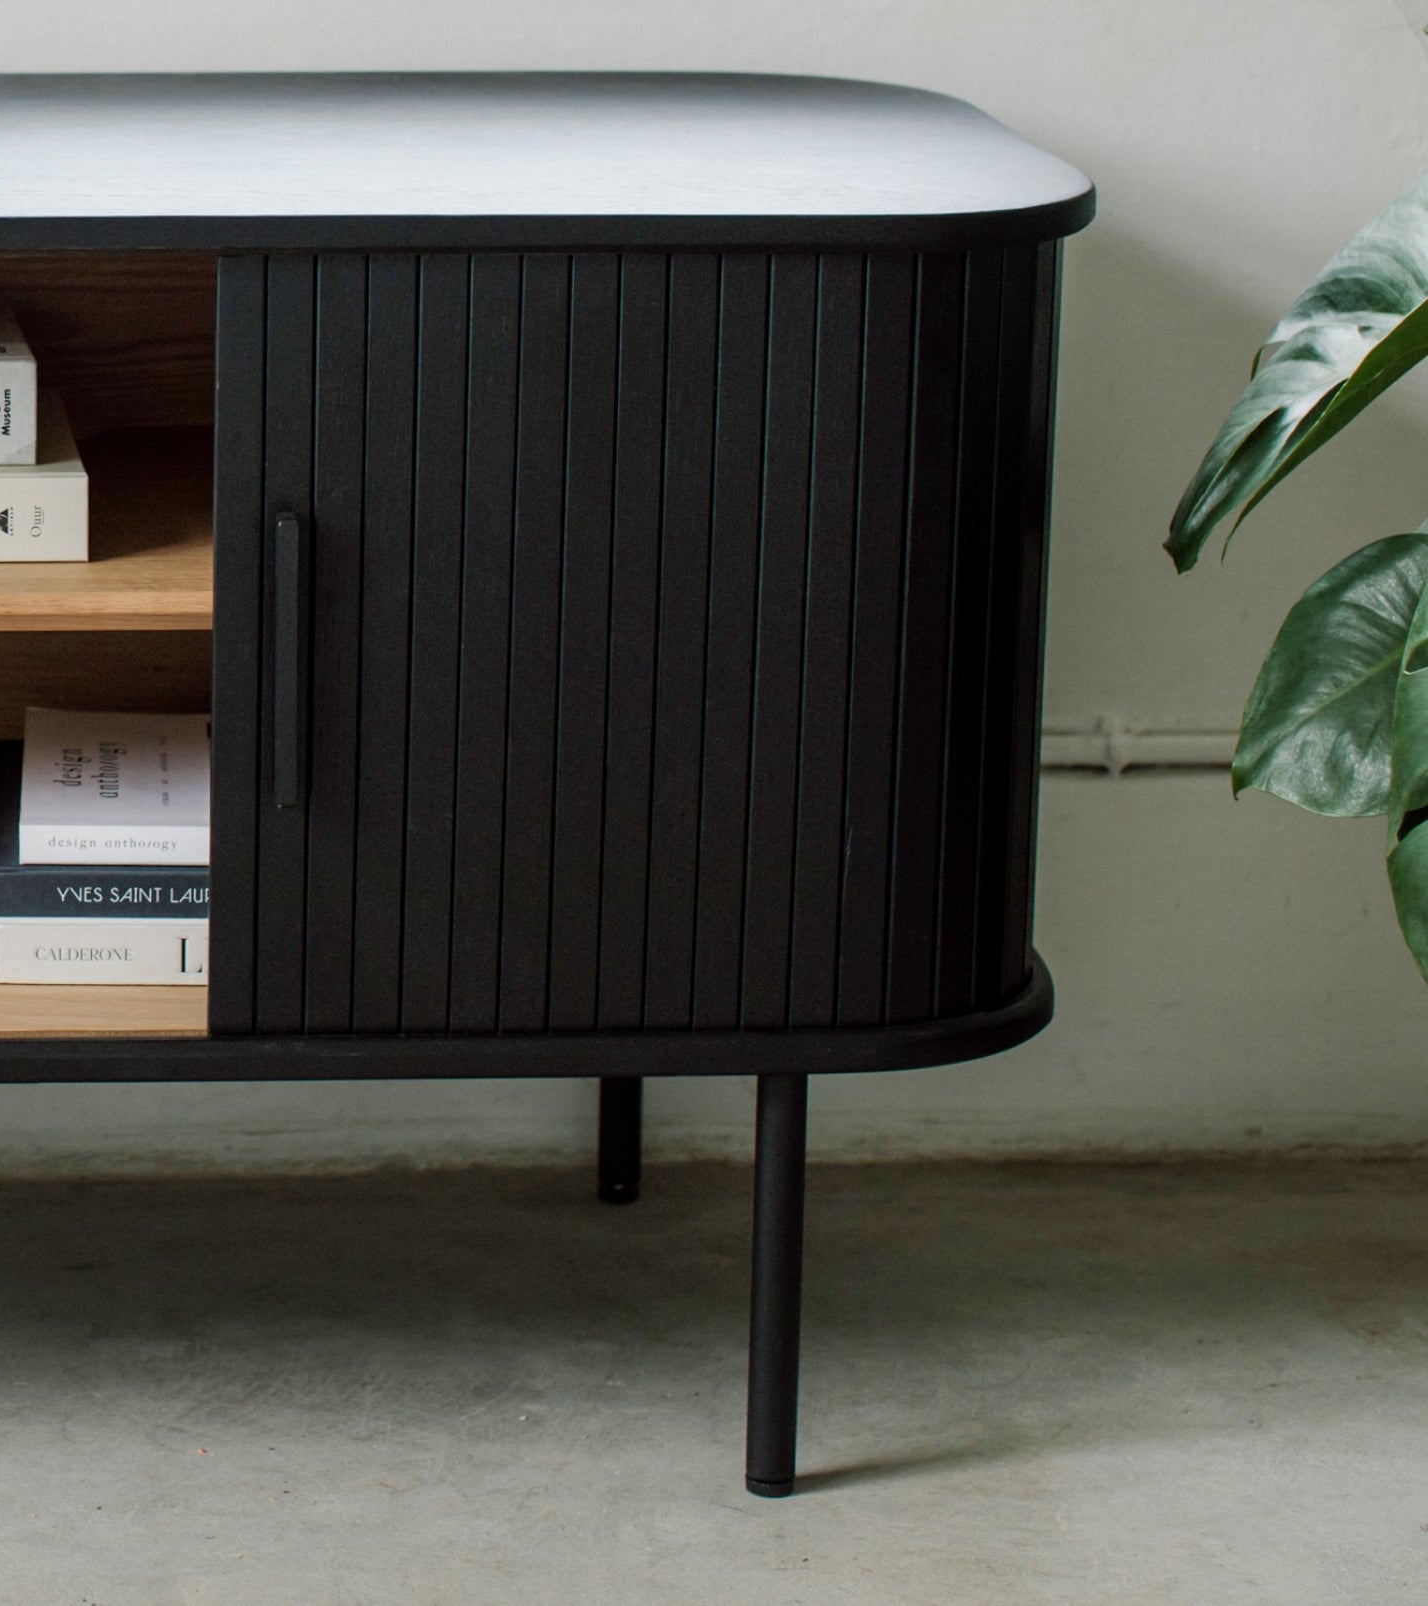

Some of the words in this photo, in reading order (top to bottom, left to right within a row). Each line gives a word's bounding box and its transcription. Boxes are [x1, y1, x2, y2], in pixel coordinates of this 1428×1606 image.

[1, 389, 11, 436] Museum
[30, 505, 42, 537] Ouur
[53, 749, 92, 787] design
[90, 742, 128, 799] anthology
[48, 837, 97, 849] design
[104, 838, 178, 852] anthology
[57, 887, 103, 903] YVES
[110, 887, 162, 903] SAINT
[35, 946, 133, 962] CALDERONE
[176, 936, 209, 973] L
